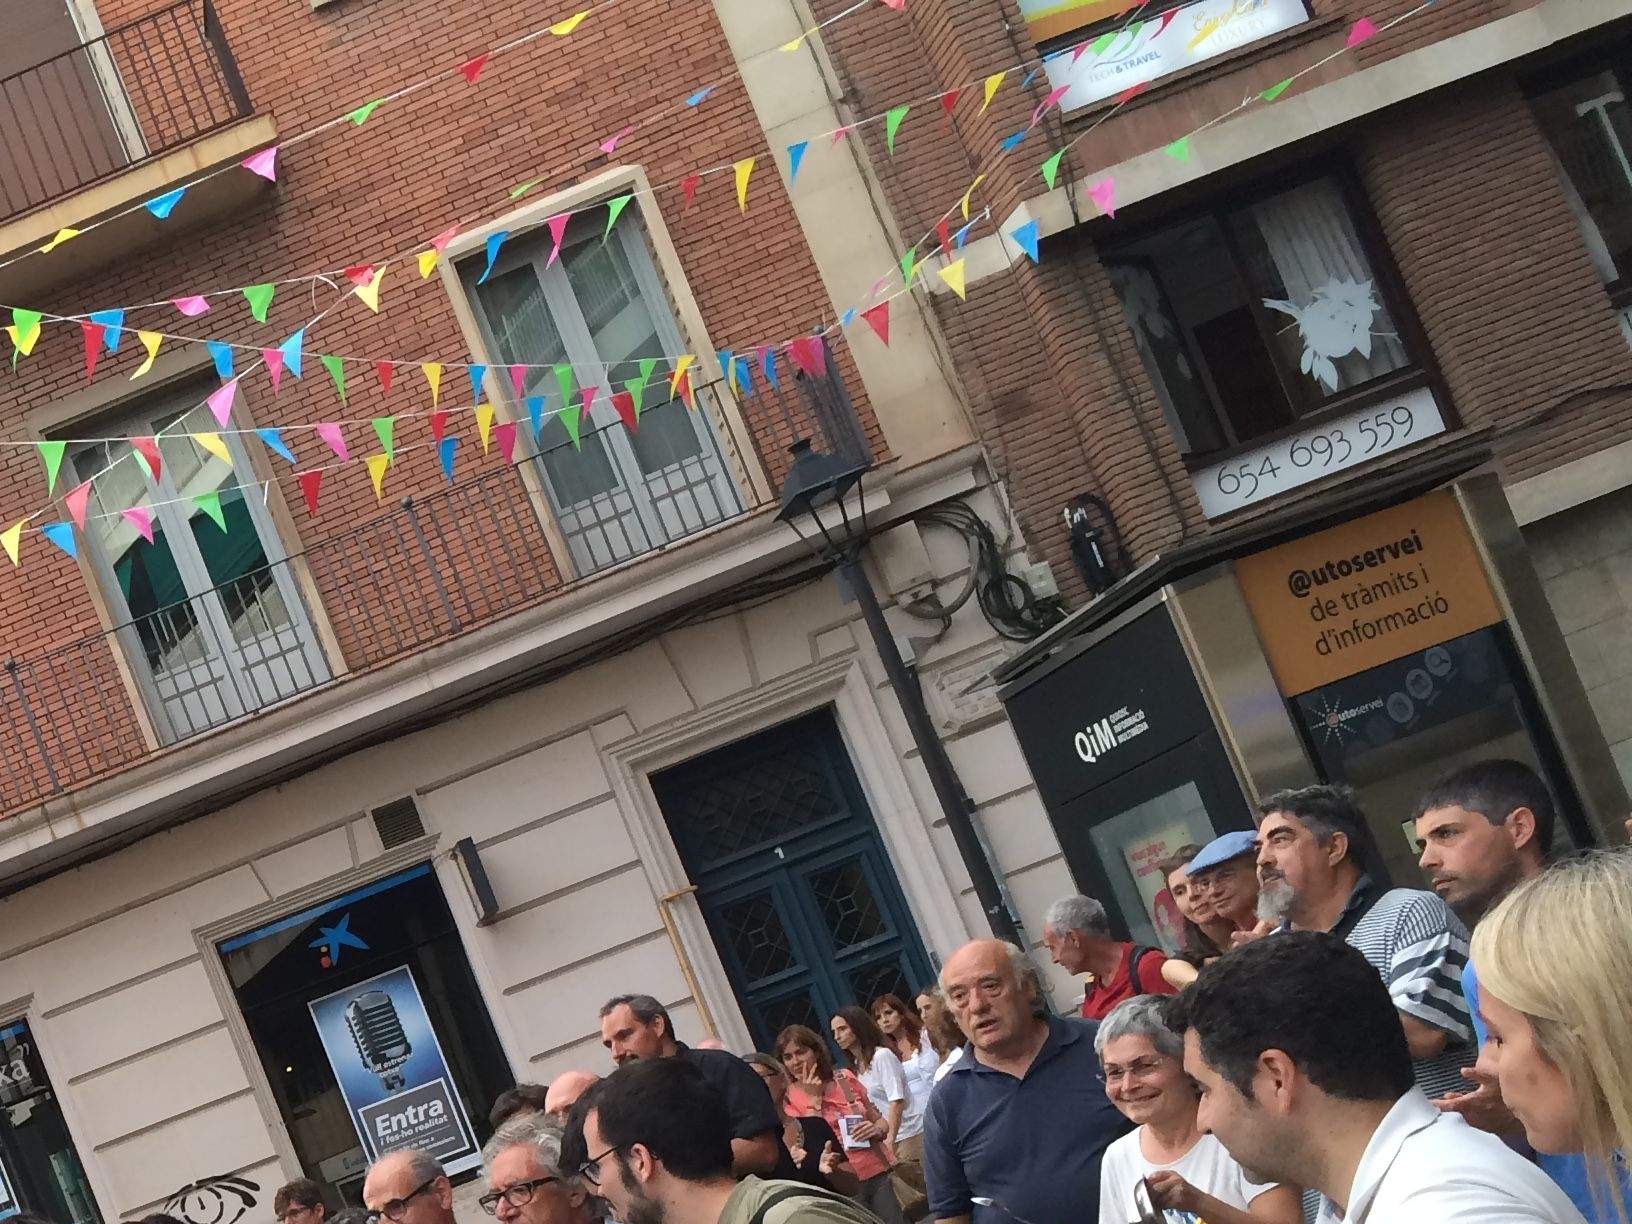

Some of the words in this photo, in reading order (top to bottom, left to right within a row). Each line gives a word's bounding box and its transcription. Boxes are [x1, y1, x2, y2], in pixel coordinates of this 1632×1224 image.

[1089, 50, 1162, 83] TECH&TRAVEL
[1218, 457, 1281, 499] 654
[1290, 429, 1352, 467] 693
[1358, 406, 1414, 454] 559
[1288, 528, 1424, 598] @utoservei
[1310, 597, 1340, 622] de
[1341, 572, 1418, 611] tràmits
[1419, 563, 1429, 583] i
[1315, 590, 1449, 656] d'informació
[1074, 718, 1118, 763] QiM
[375, 1099, 444, 1137] Entra
[415, 1114, 448, 1133] realitat
